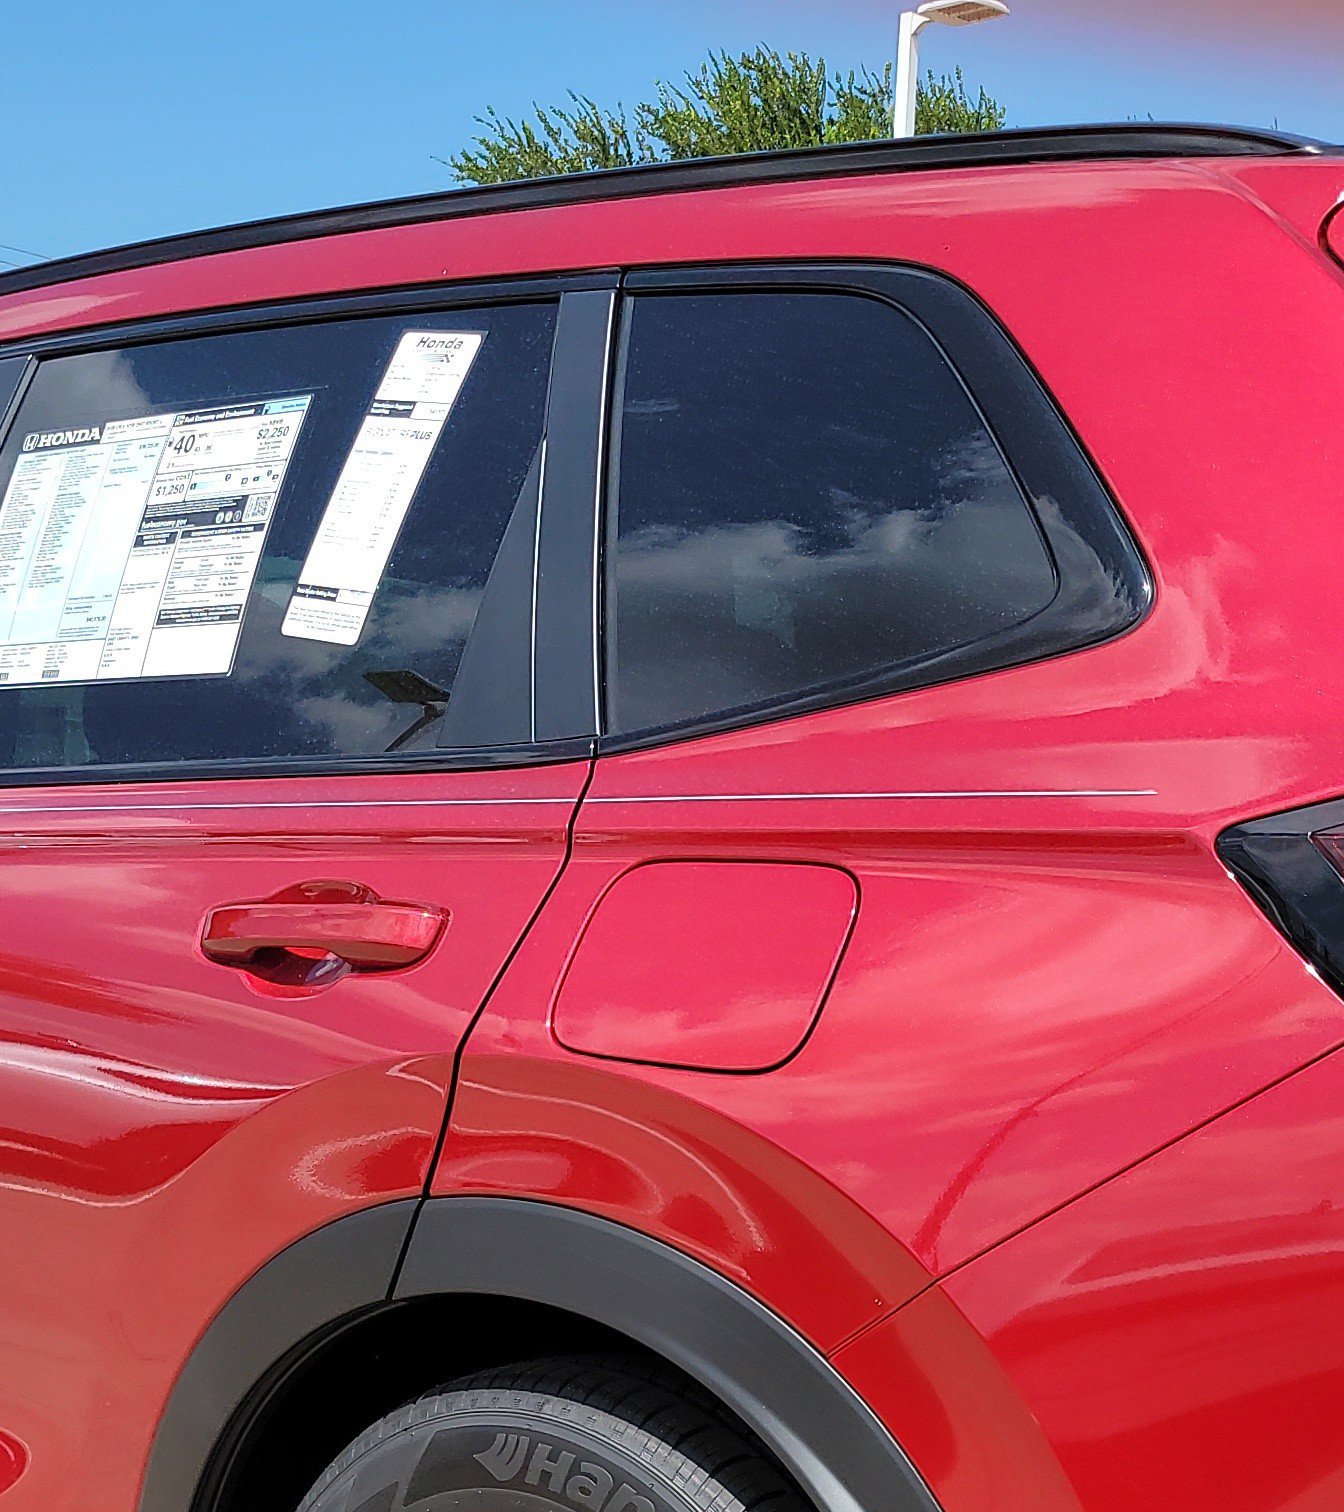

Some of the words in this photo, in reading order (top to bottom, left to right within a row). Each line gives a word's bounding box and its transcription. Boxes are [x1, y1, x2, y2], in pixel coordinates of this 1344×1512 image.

[416, 337, 464, 350] Honda
[37, 427, 101, 448] HONDA
[257, 426, 290, 440] $2,250
[173, 434, 196, 454] 40
[156, 483, 185, 496] $1,250
